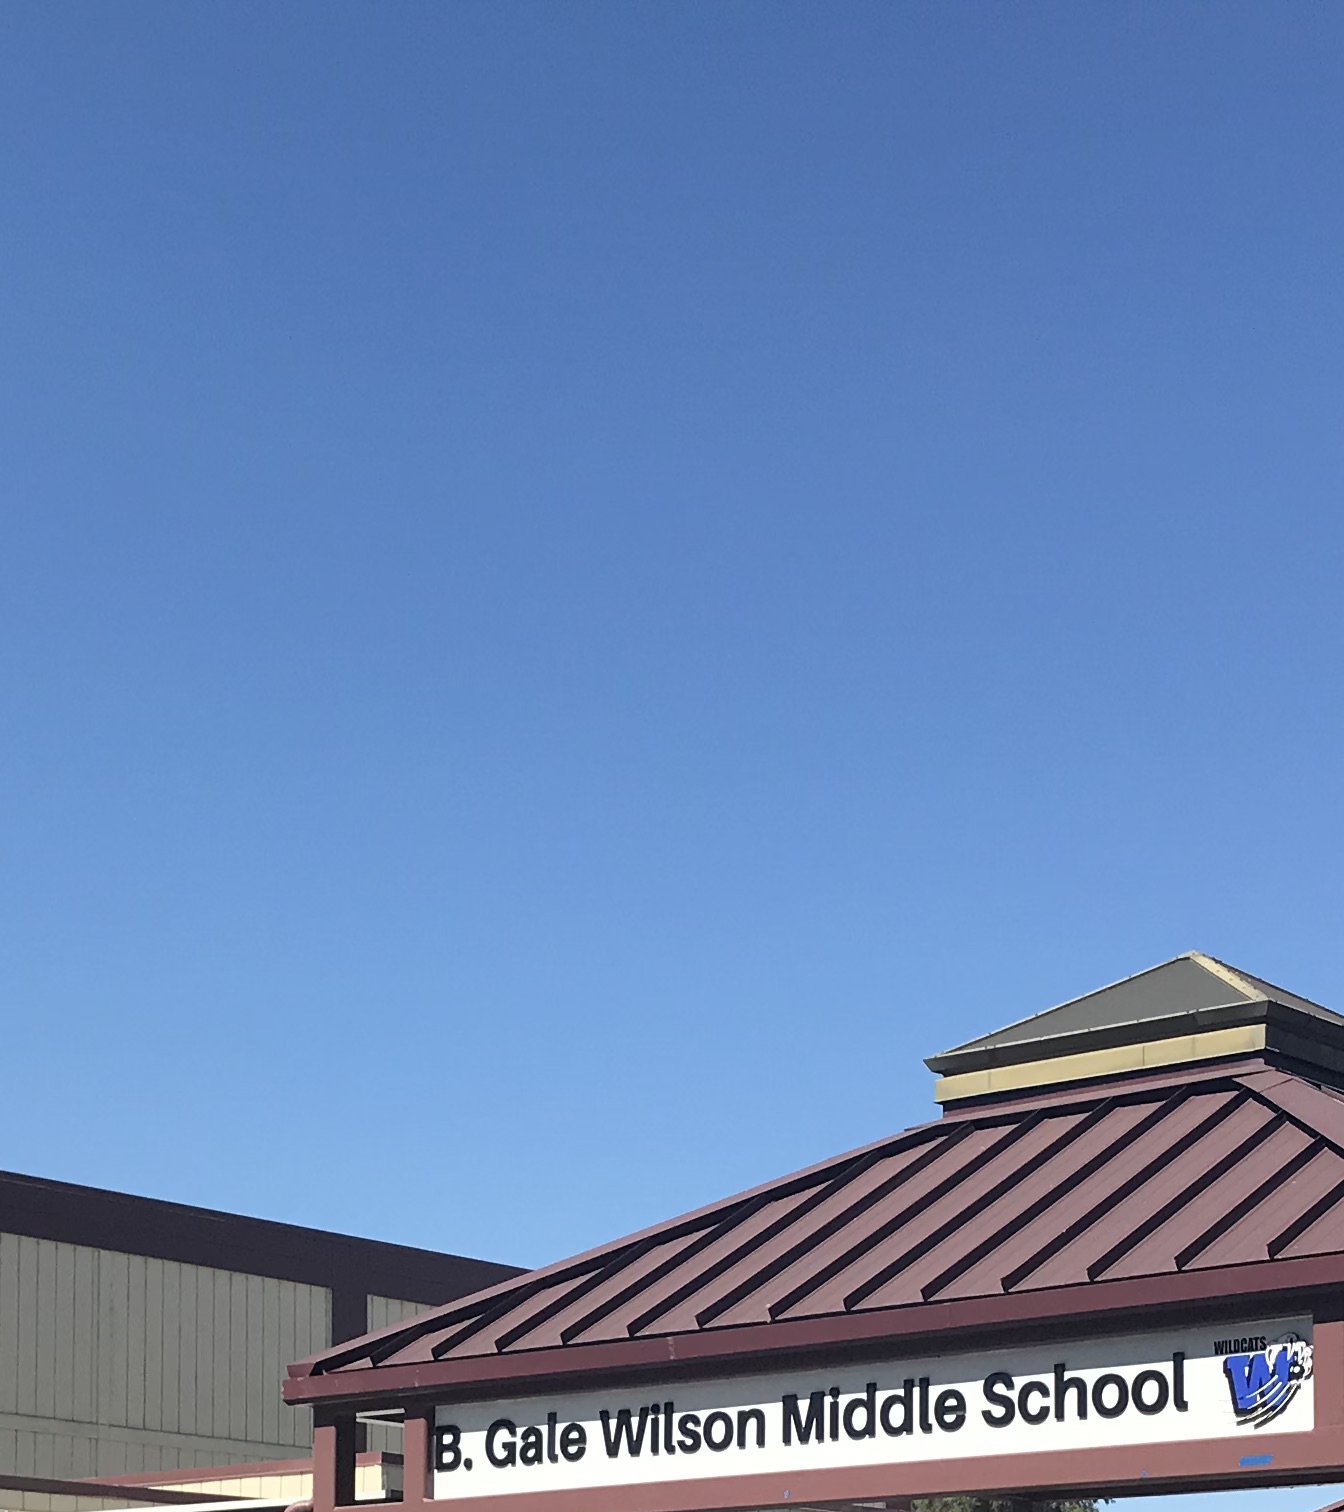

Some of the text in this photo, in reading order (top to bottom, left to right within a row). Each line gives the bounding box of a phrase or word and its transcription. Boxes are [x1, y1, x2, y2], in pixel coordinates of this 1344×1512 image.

[1214, 1336, 1267, 1355] WILDCATS
[433, 1352, 1188, 1473] B. Gale Wilson Middle School
